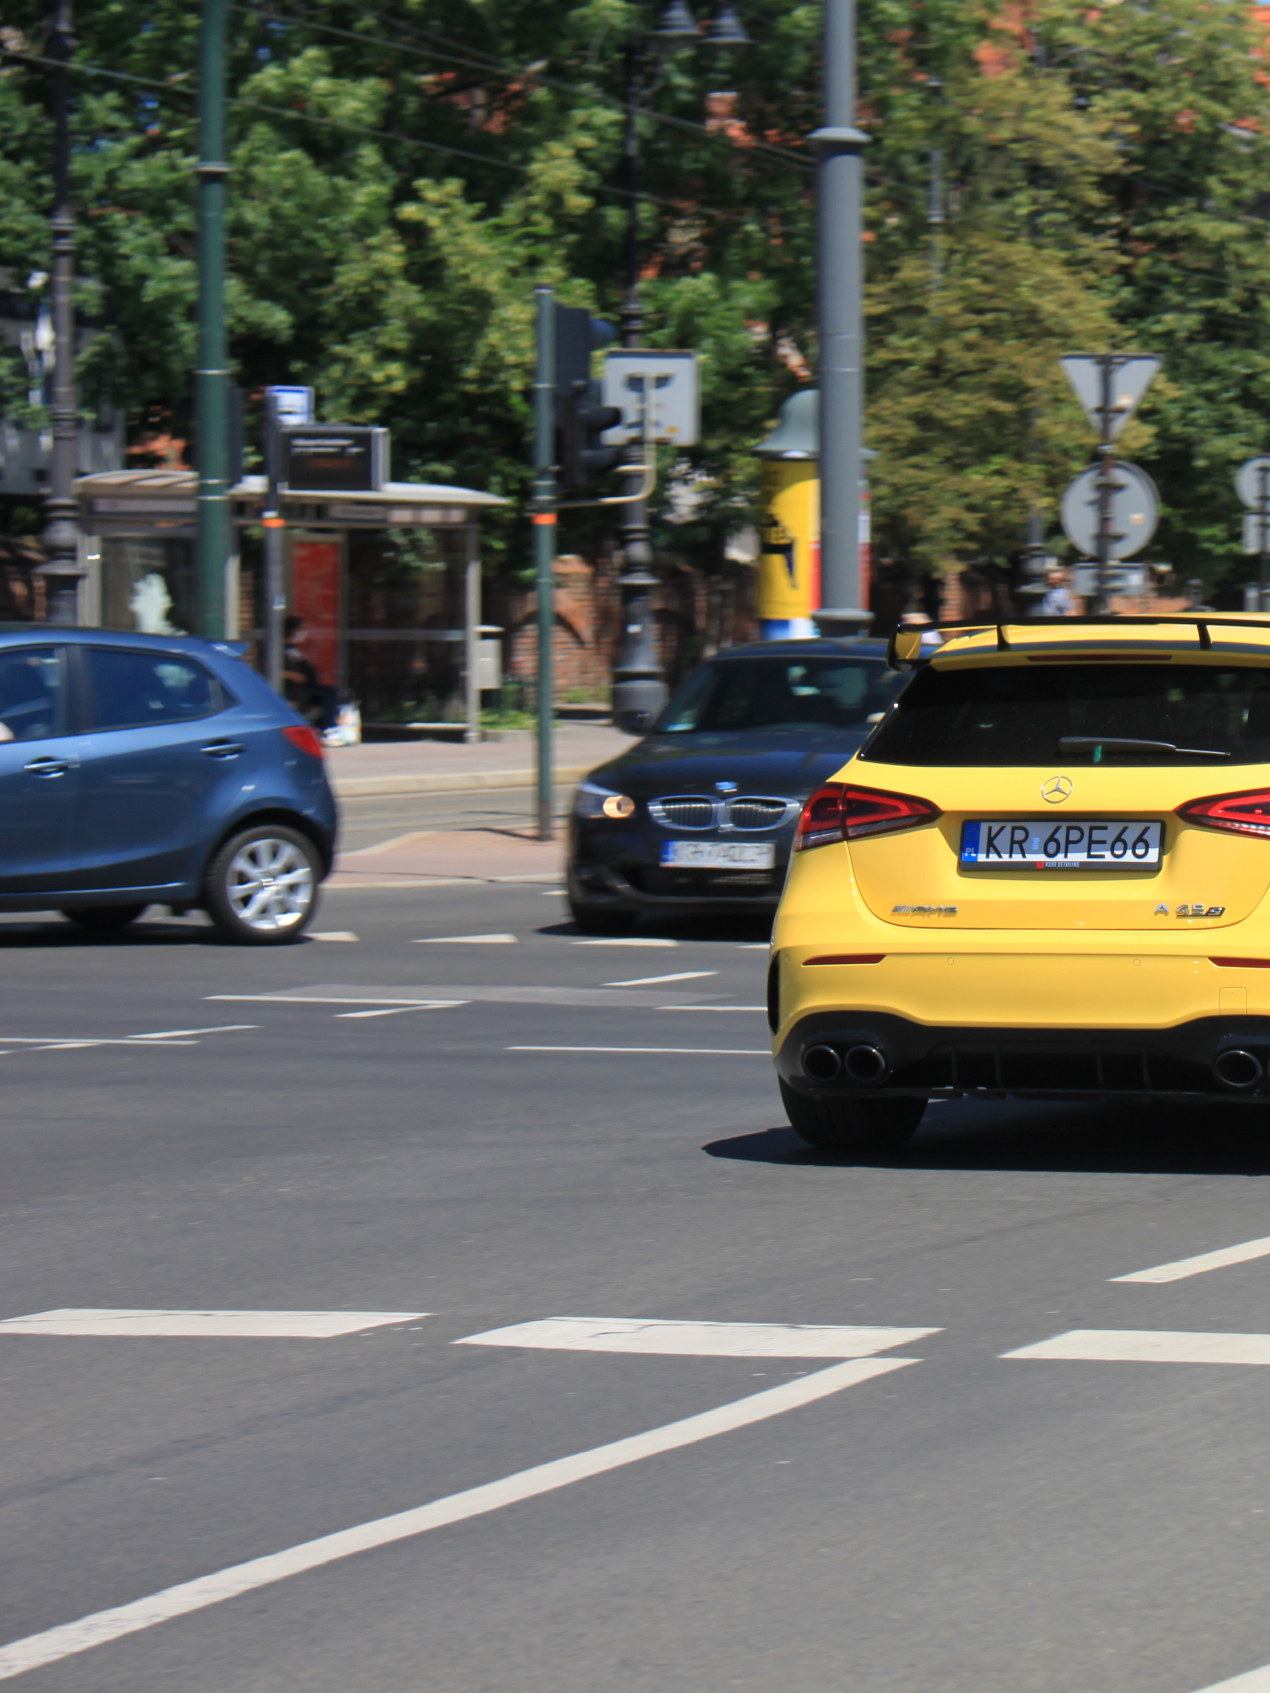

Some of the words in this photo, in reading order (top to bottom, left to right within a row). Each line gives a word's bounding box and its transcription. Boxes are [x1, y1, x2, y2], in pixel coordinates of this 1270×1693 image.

[986, 825, 1029, 859] KR
[1043, 825, 1152, 860] 6PE66
[965, 847, 977, 857] PL
[1155, 903, 1169, 914] A
